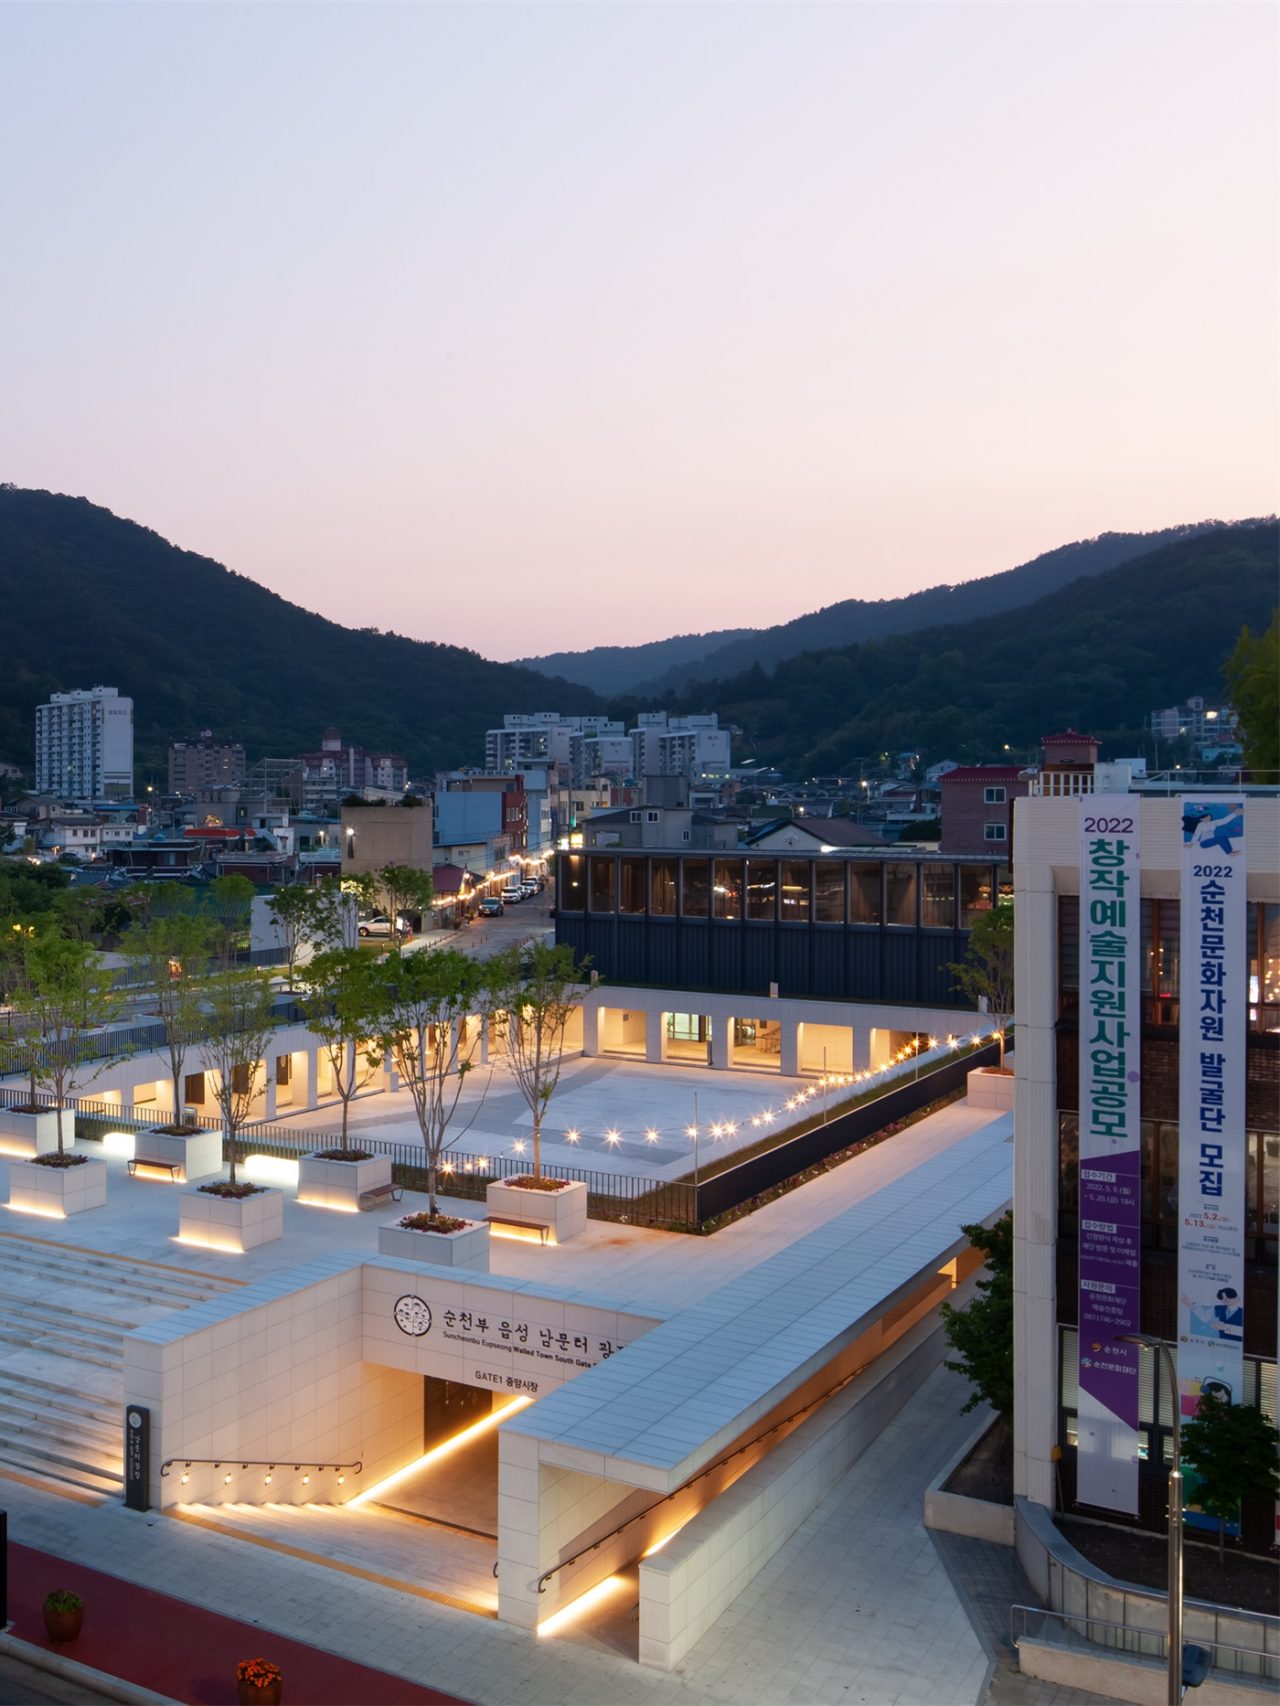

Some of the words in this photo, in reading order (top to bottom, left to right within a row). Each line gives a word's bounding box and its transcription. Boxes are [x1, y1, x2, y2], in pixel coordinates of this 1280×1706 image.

[1084, 817, 1134, 834] 2022
[1193, 865, 1233, 879] 2022
[1199, 880, 1227, 1043] 순천문화자원
[1088, 838, 1130, 1139] 창작예술지원사업공모
[1199, 1052, 1227, 1133] 발굴단
[1199, 1142, 1225, 1198] 모집
[443, 1309, 489, 1334] 순천부
[498, 1321, 528, 1343] 읍성
[540, 1328, 588, 1354] 남문터
[443, 1331, 480, 1345] Suncheonbu
[482, 1339, 513, 1352] Eupseong
[513, 1345, 535, 1356] Walled
[536, 1350, 553, 1360] Town
[554, 1354, 574, 1365] South
[575, 1359, 592, 1369] Gate
[474, 1370, 503, 1385] GATE1
[505, 1376, 539, 1393] 중앙시장
